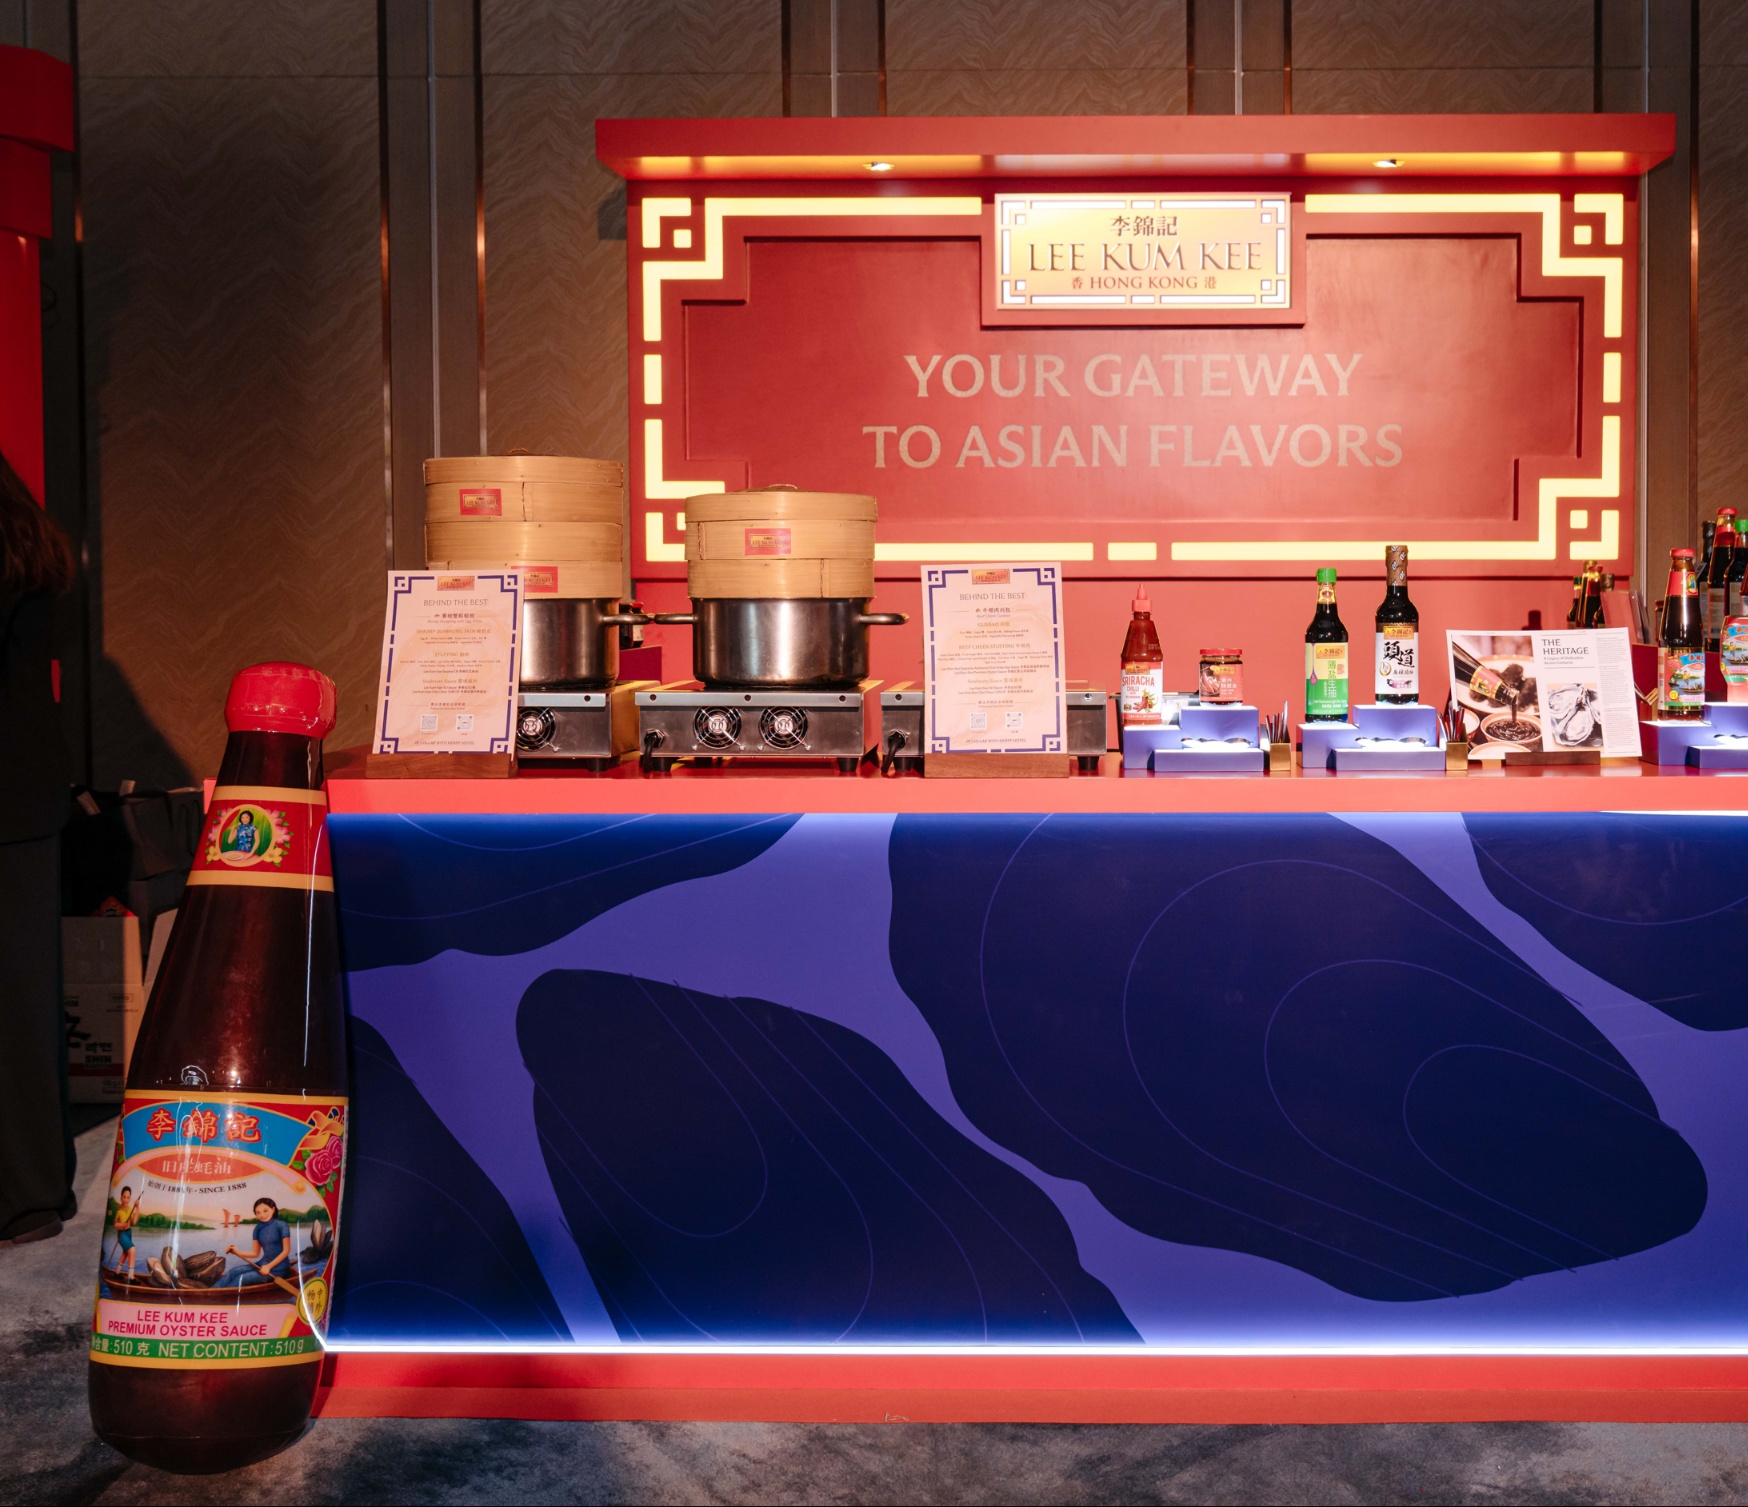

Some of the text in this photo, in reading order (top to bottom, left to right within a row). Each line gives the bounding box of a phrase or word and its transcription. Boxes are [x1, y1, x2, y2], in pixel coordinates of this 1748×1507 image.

[1111, 215, 1179, 237] 李錦記
[1028, 241, 1262, 271] LEE KUM KEE
[1071, 276, 1217, 290] 香 HONG KONG 港
[904, 353, 1363, 398] YOUR GATEWAY
[862, 424, 1403, 468] TO ASIAN FLAVORS
[423, 599, 452, 607] BEHIND
[959, 593, 989, 601] BEHIND
[1543, 647, 1589, 655] HERITAGE
[1122, 675, 1155, 687] SRIRACHA
[85, 1055, 113, 1064] SHIN
[147, 1107, 262, 1143] 李錦記
[199, 1186, 226, 1194] SINCE
[227, 1182, 247, 1191] 1888
[137, 1309, 228, 1324] LEE KUM KEE
[108, 1320, 267, 1338] PREMIUM OYSTER SAUCE
[158, 1343, 191, 1358] NET
